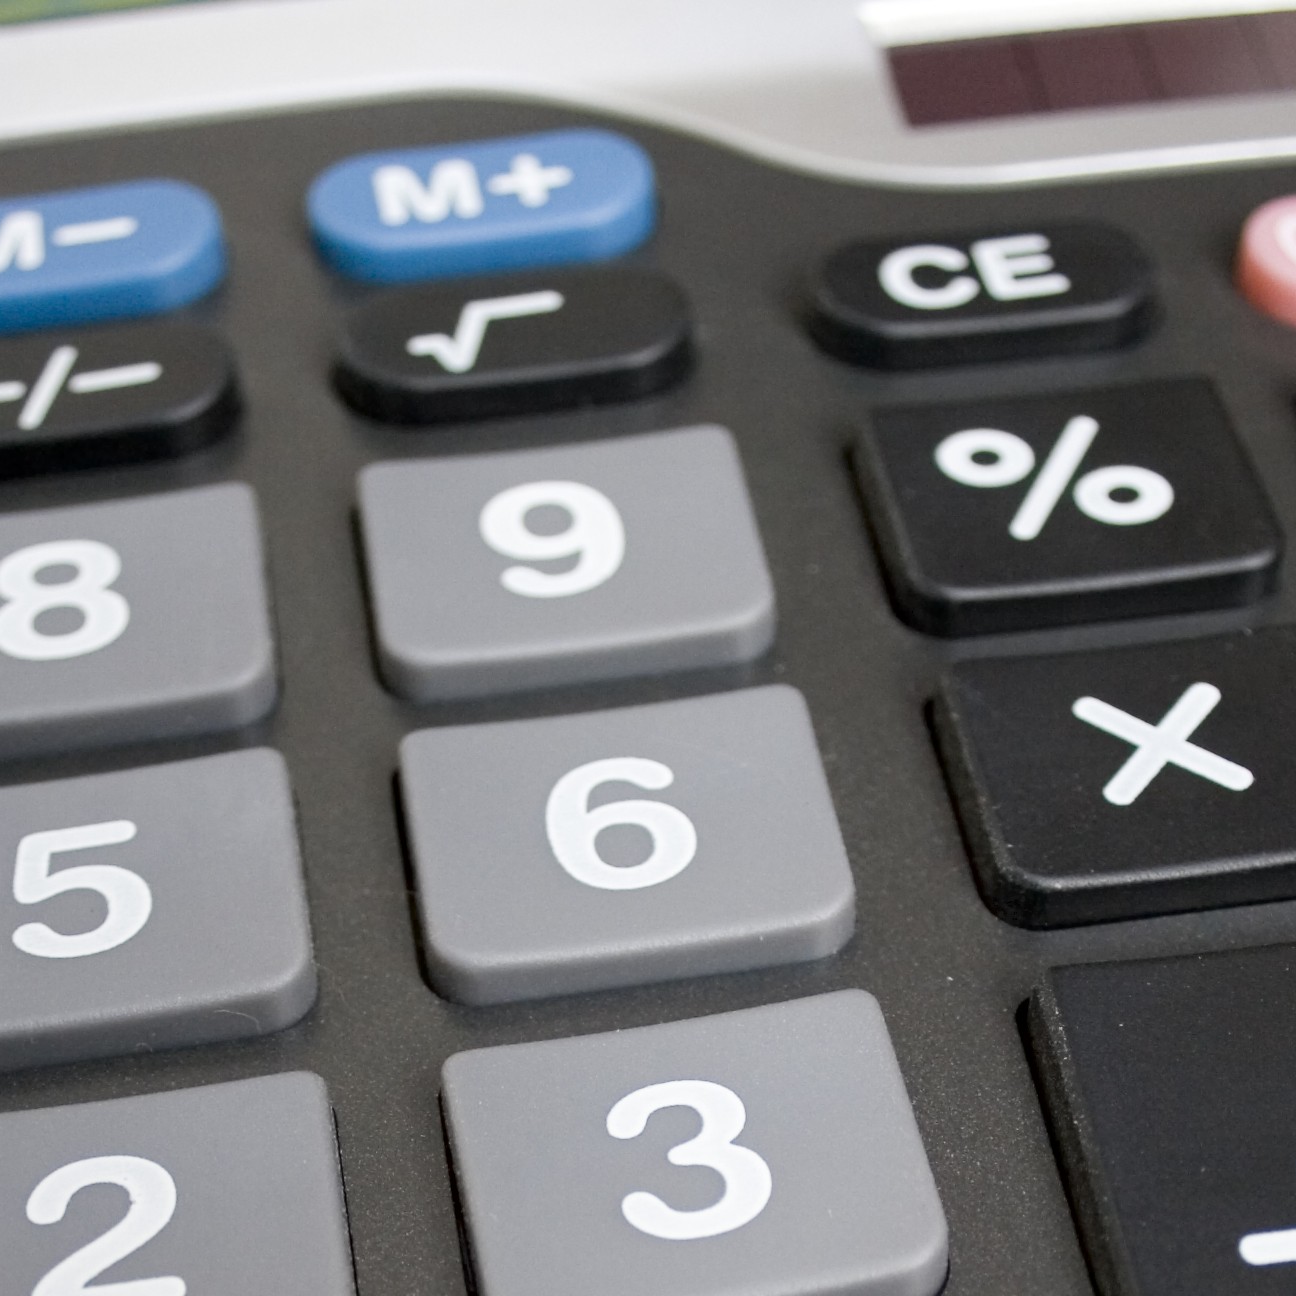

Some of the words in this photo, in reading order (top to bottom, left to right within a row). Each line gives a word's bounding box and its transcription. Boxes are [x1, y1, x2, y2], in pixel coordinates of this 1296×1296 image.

[374, 155, 571, 224] M+
[880, 235, 1069, 309] CE
[481, 482, 624, 597] 9
[936, 416, 1173, 540] %
[546, 757, 696, 889] 6
[13, 820, 152, 957] 5
[607, 1080, 772, 1239] 3
